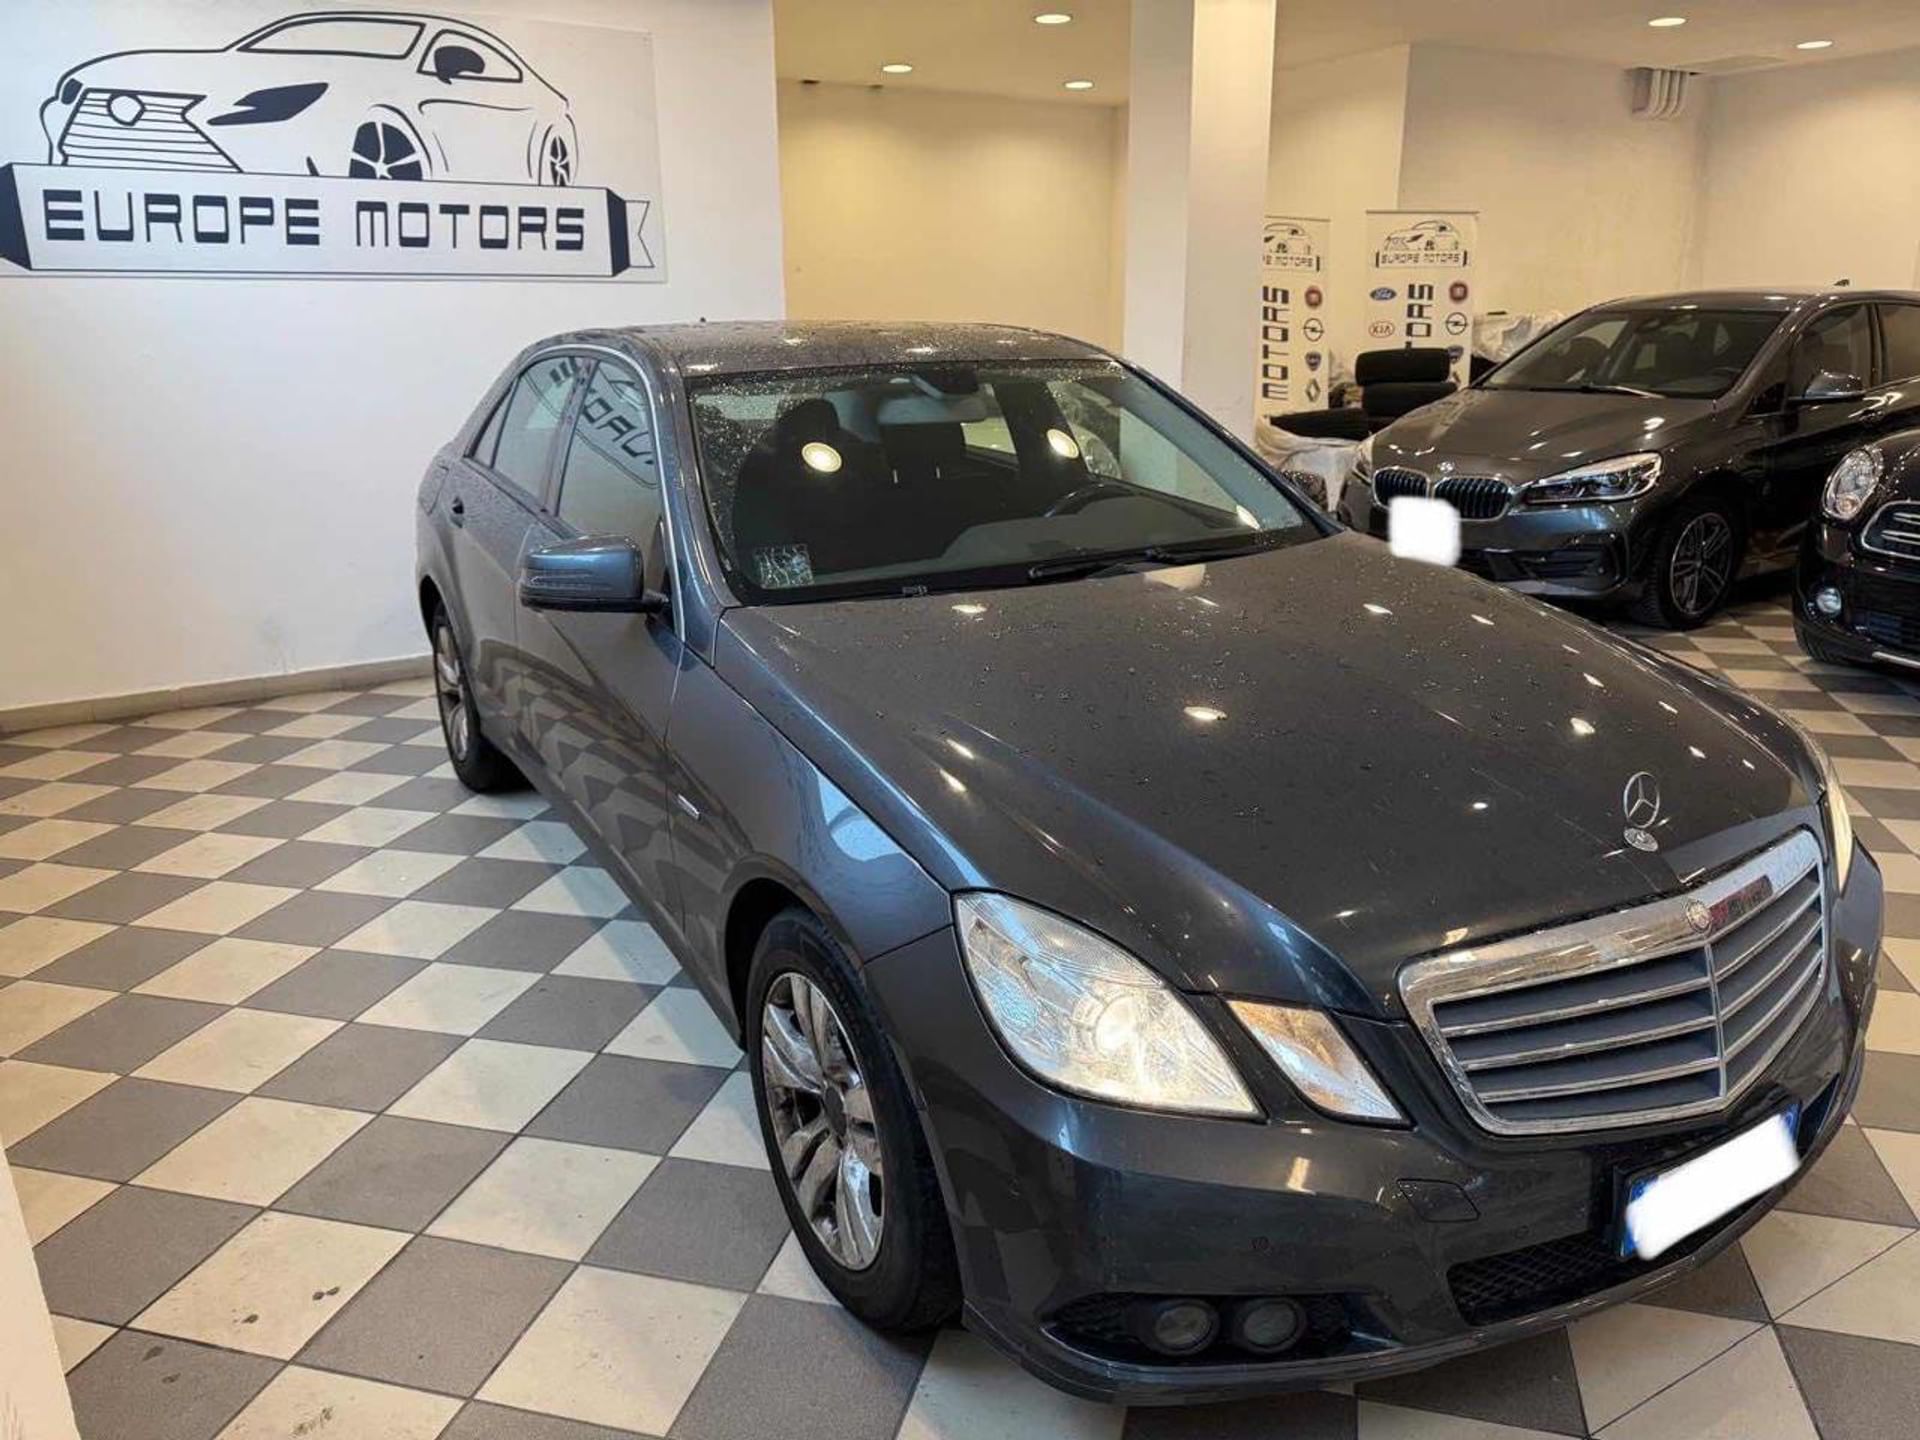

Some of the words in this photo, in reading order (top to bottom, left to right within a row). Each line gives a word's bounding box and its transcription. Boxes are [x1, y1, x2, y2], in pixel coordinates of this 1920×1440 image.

[43, 189, 320, 246] EUROPE
[356, 201, 584, 251] MOTORS
[1262, 285, 1290, 401] MOTORS
